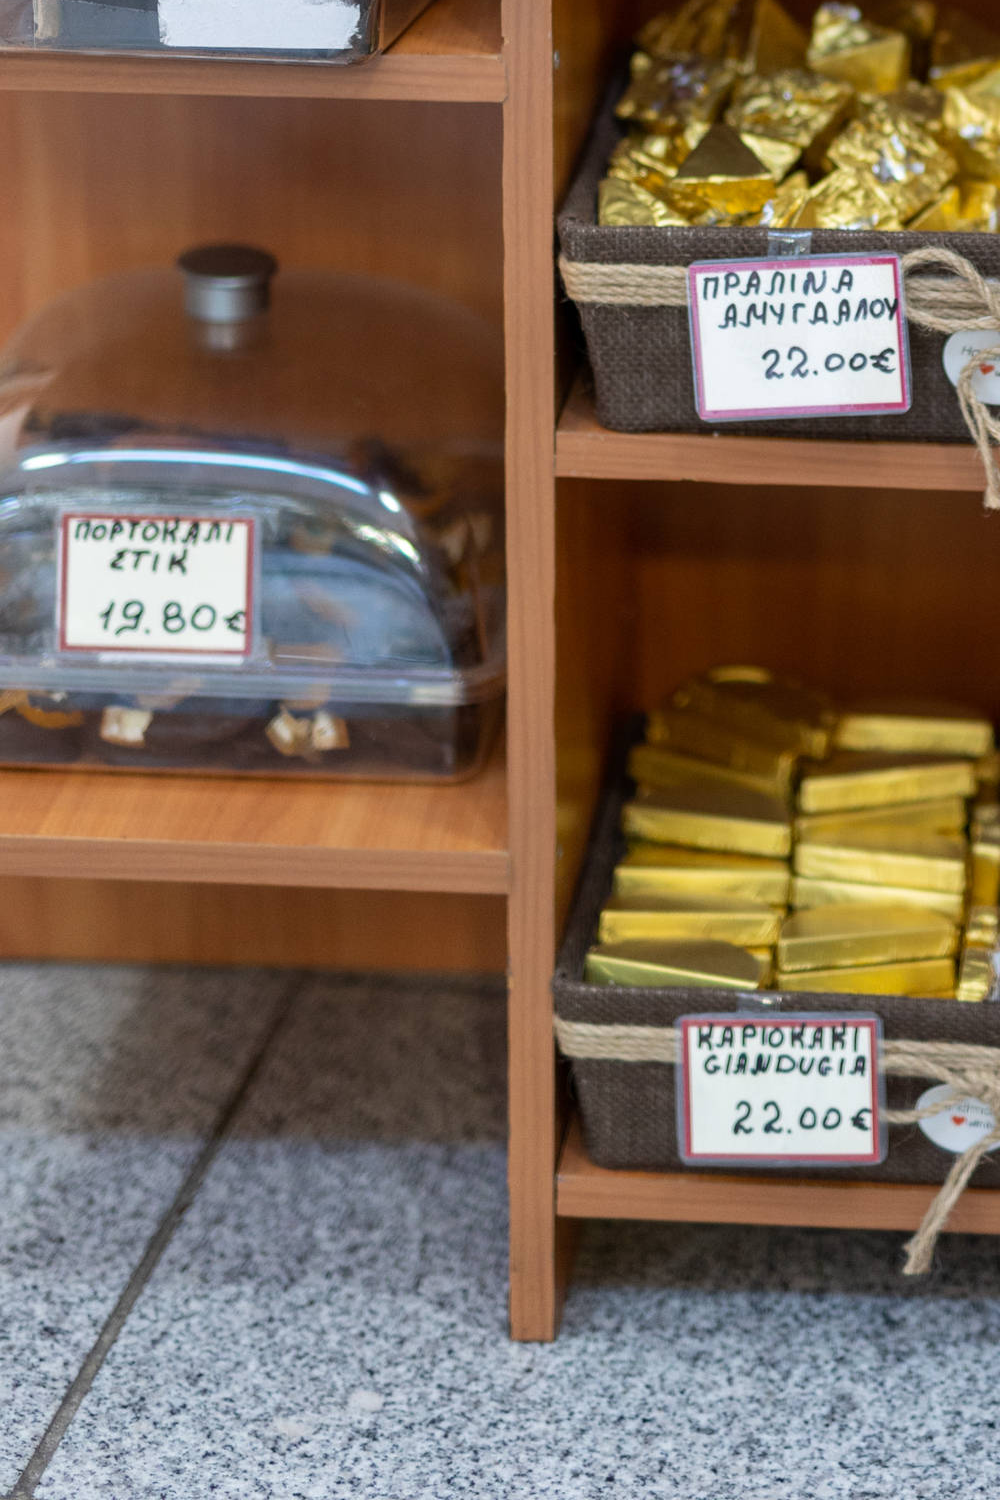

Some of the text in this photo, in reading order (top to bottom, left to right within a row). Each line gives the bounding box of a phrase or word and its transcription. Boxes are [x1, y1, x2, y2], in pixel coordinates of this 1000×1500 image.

[703, 268, 854, 301] ΠΡΑΛΙΝΑ
[762, 346, 896, 380] 22.00€
[74, 517, 234, 546] ΠΟΡΤΟΚΑΛΙ
[109, 549, 188, 575] ΣΤΙΚ
[100, 600, 246, 636] 19.80€
[697, 1022, 859, 1052] ΚΑΡΙΟΚΑΚΙ
[732, 1100, 872, 1135] 22.00€
